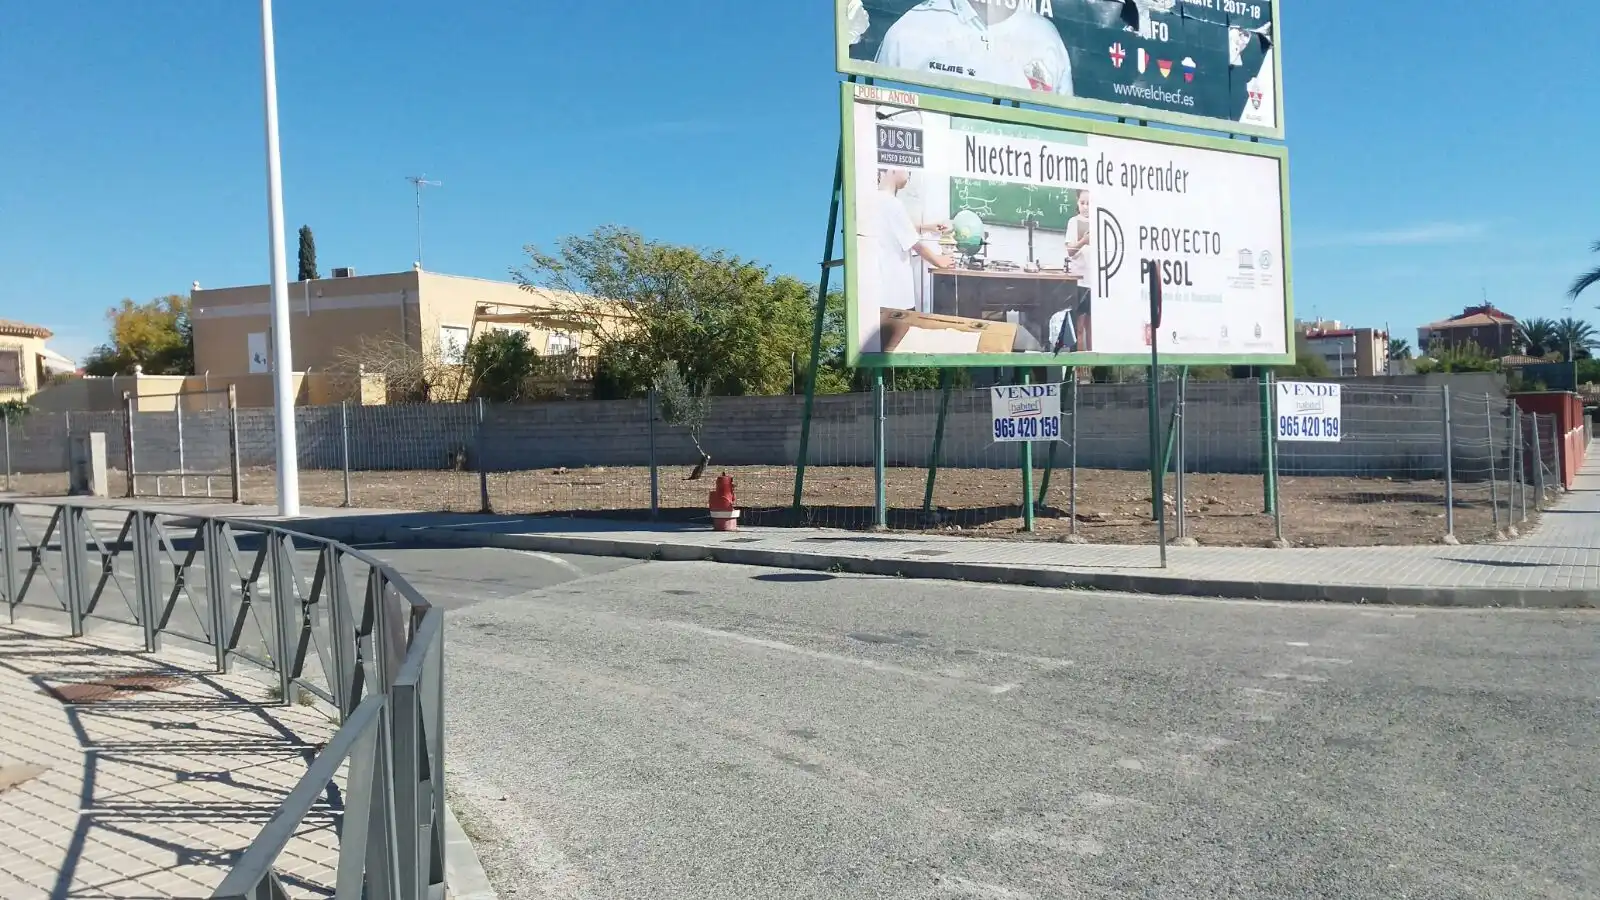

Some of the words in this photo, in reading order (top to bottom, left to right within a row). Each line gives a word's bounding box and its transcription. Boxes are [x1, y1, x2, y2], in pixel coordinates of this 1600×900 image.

[1224, 0, 1261, 19] 2017-18
[929, 61, 963, 74] KELME
[888, 91, 916, 105] ANTON
[1113, 82, 1195, 106] www.elchecf.es
[880, 128, 921, 151] PUSOL
[880, 152, 898, 163] MUSEO
[899, 153, 921, 165] ESCOLAR
[966, 134, 1033, 178] Nuestra
[1039, 145, 1089, 183] forma
[1096, 152, 1114, 187] de
[1120, 160, 1190, 197] aprender
[1139, 225, 1222, 255] PROYECTO
[1140, 258, 1194, 287] PSOL
[994, 384, 1057, 399] VENDE
[1281, 383, 1339, 397] VENDE
[994, 418, 1016, 438] 965
[1018, 417, 1037, 438] 420
[1040, 416, 1059, 437] 159
[1280, 416, 1299, 436] 965
[1301, 416, 1320, 437] 420
[1322, 417, 1339, 437] 159
